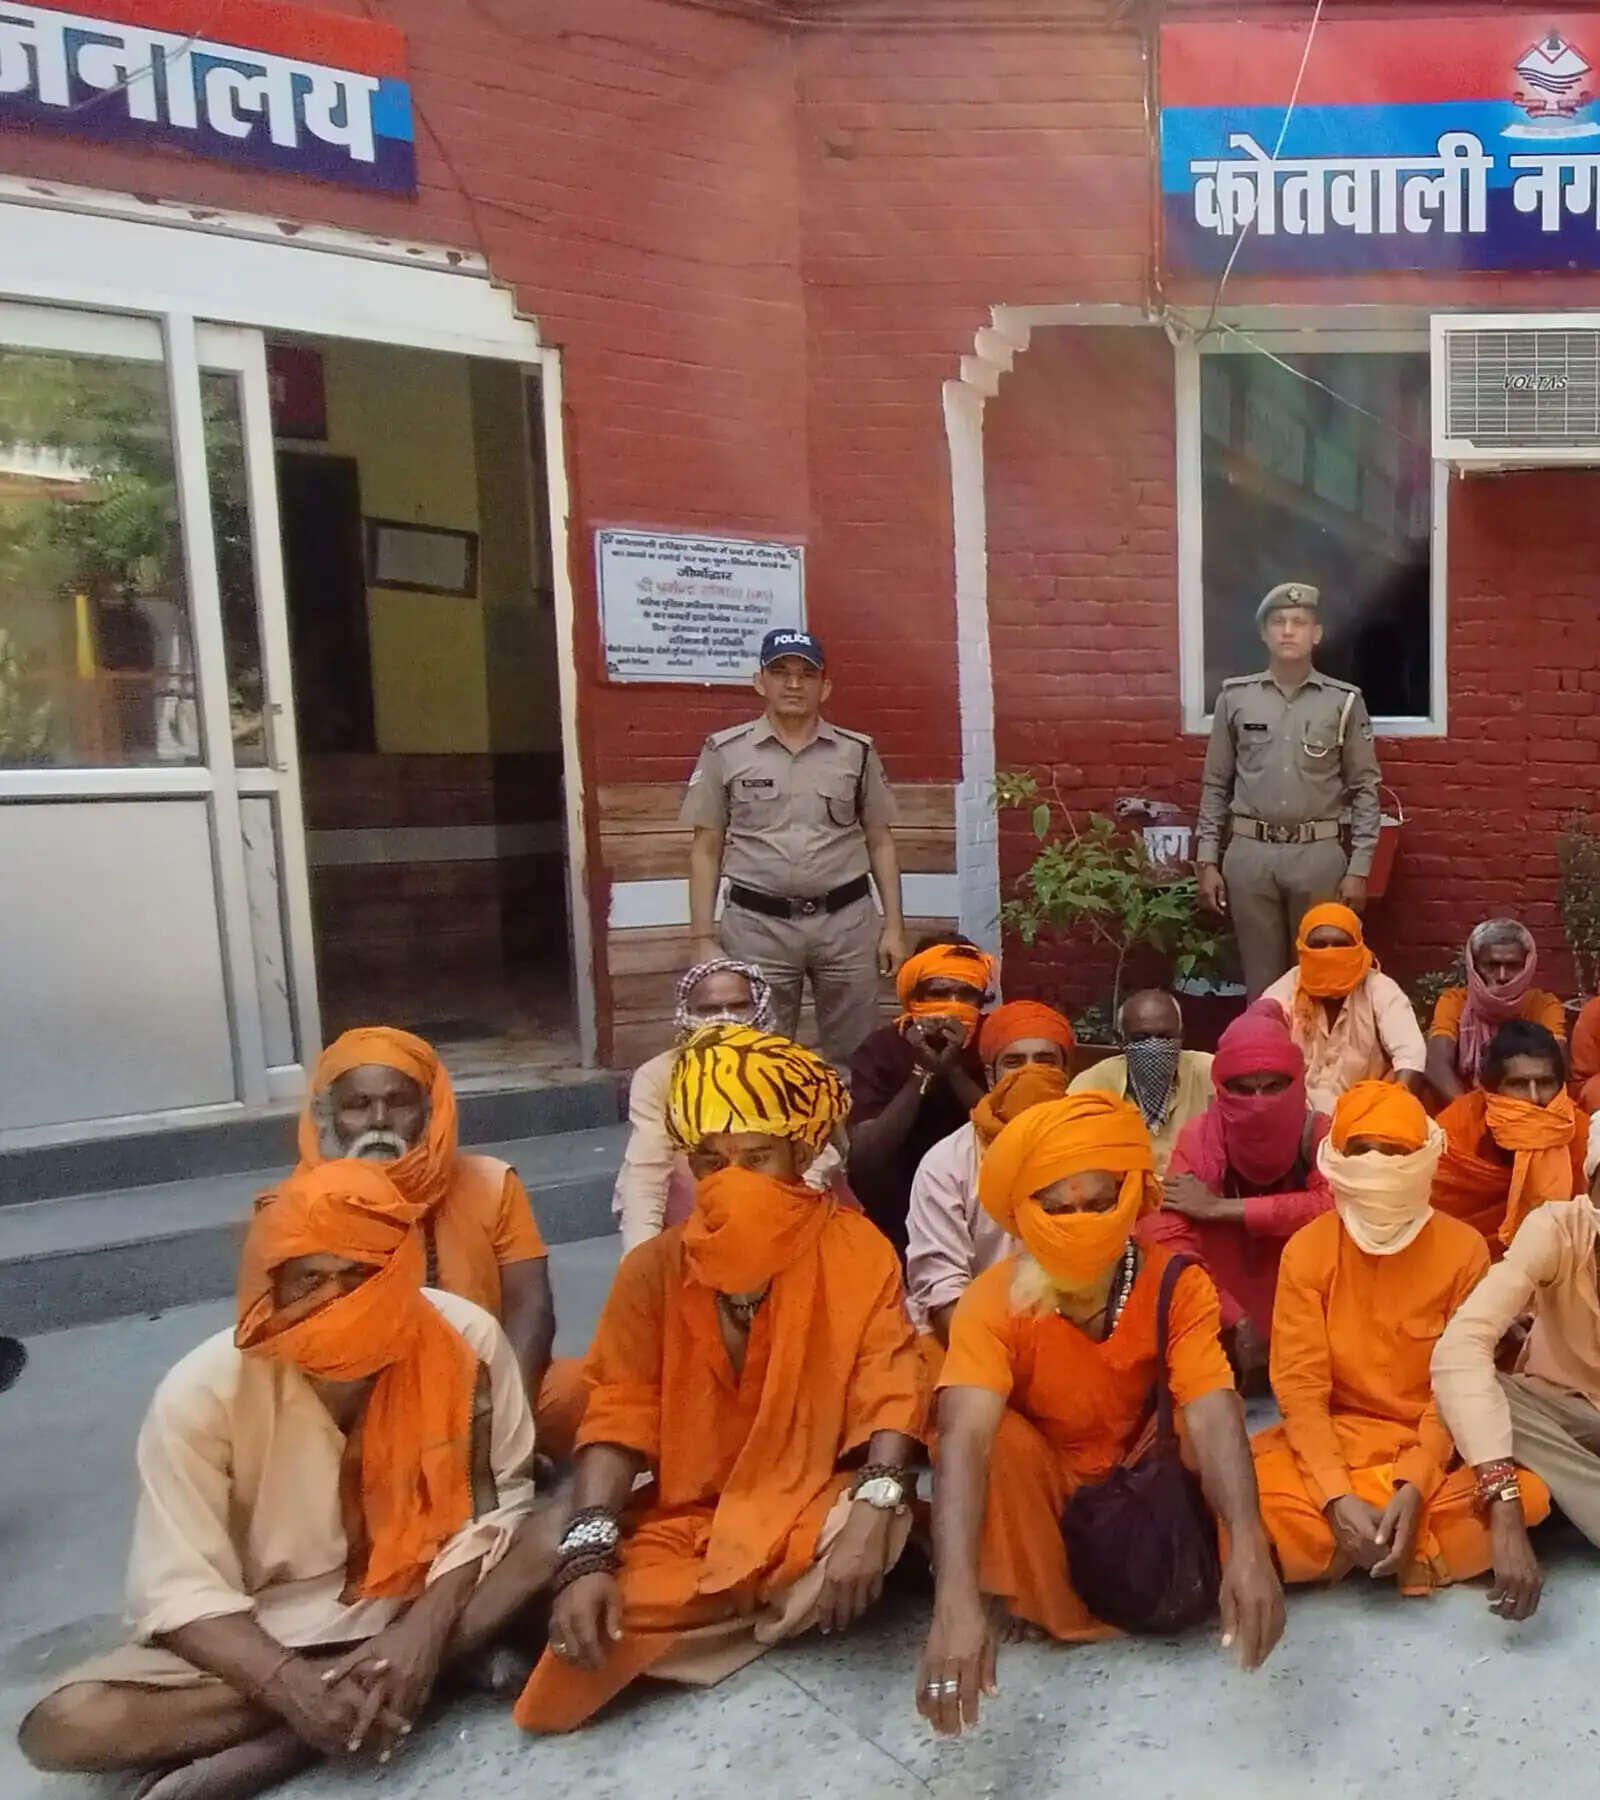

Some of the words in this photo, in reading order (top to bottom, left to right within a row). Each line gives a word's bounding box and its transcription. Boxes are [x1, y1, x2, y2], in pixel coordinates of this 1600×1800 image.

[1190, 131, 1493, 236] कोतवाली
[1503, 374, 1569, 391] VOLTAS
[774, 633, 812, 646] POLICE
